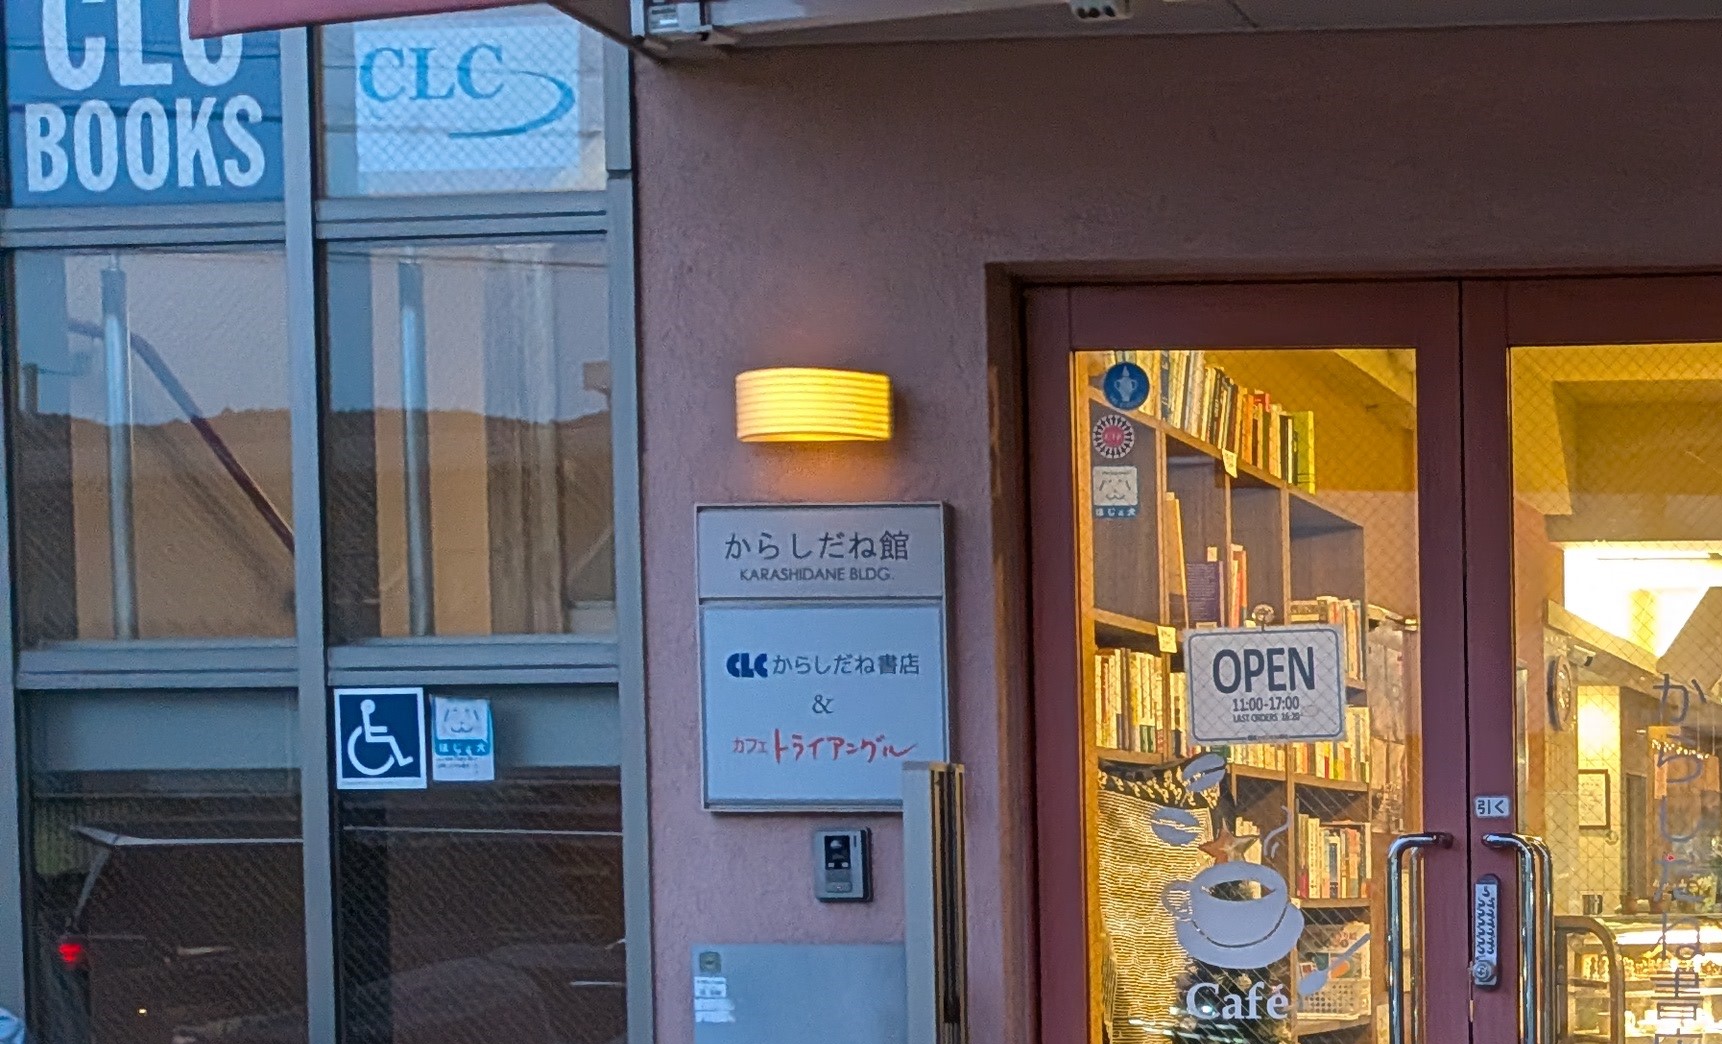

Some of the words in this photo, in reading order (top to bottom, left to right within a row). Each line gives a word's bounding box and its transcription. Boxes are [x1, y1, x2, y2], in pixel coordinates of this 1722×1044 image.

[359, 43, 503, 102] CLC
[24, 94, 265, 193] BOOKS
[725, 529, 909, 560] からしだね館
[740, 567, 845, 581] KARASHIDANE
[849, 567, 895, 581] BLDG.
[726, 652, 769, 678] CLC
[772, 653, 920, 675] からしだね書店
[1212, 646, 1316, 694] OPEN
[811, 694, 834, 714] &
[1232, 696, 1300, 712] 11:00-17:00
[1233, 713, 1250, 722] LAST
[1250, 712, 1278, 722] ORDERS
[733, 737, 768, 754] カフェ
[774, 728, 918, 764] トライアングル
[1477, 799, 1505, 815] 引く
[1186, 982, 1289, 1020] Café
